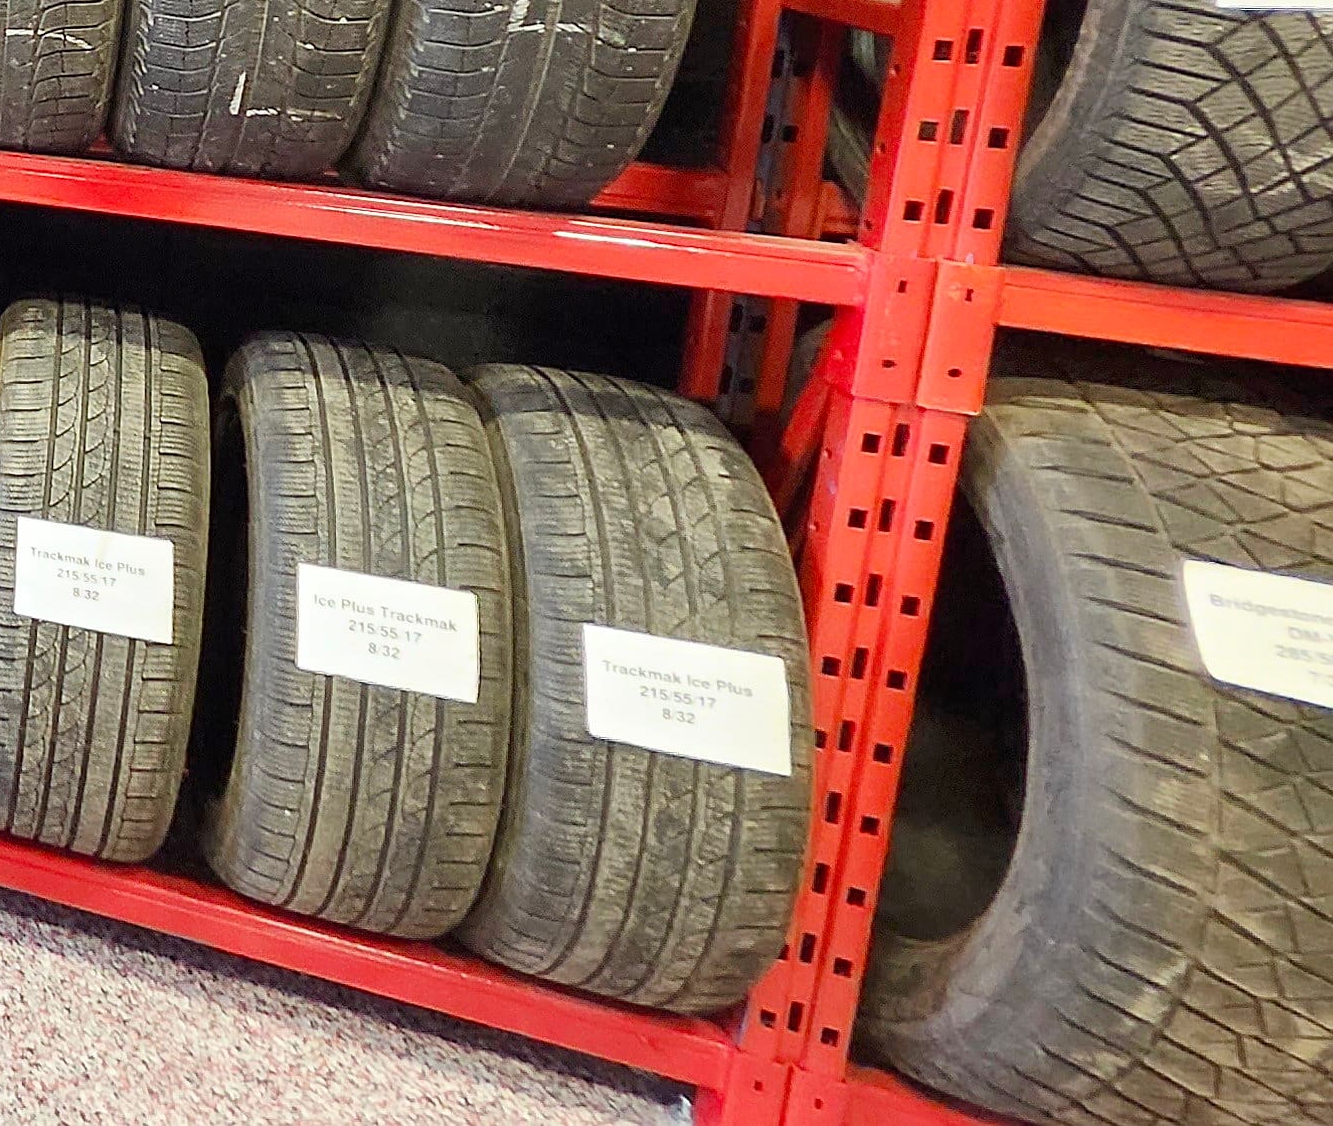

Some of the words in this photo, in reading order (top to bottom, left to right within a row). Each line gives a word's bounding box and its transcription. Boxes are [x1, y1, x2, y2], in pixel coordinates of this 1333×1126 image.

[31, 546, 90, 568] Trackmak
[94, 559, 113, 571] Ice
[117, 562, 145, 577] Plus
[314, 594, 336, 609] Ice
[341, 598, 375, 616] Plus
[381, 606, 458, 632] Trackmak
[602, 659, 681, 685] Trackmak
[687, 674, 710, 689] Ice
[716, 679, 753, 698] Plus
